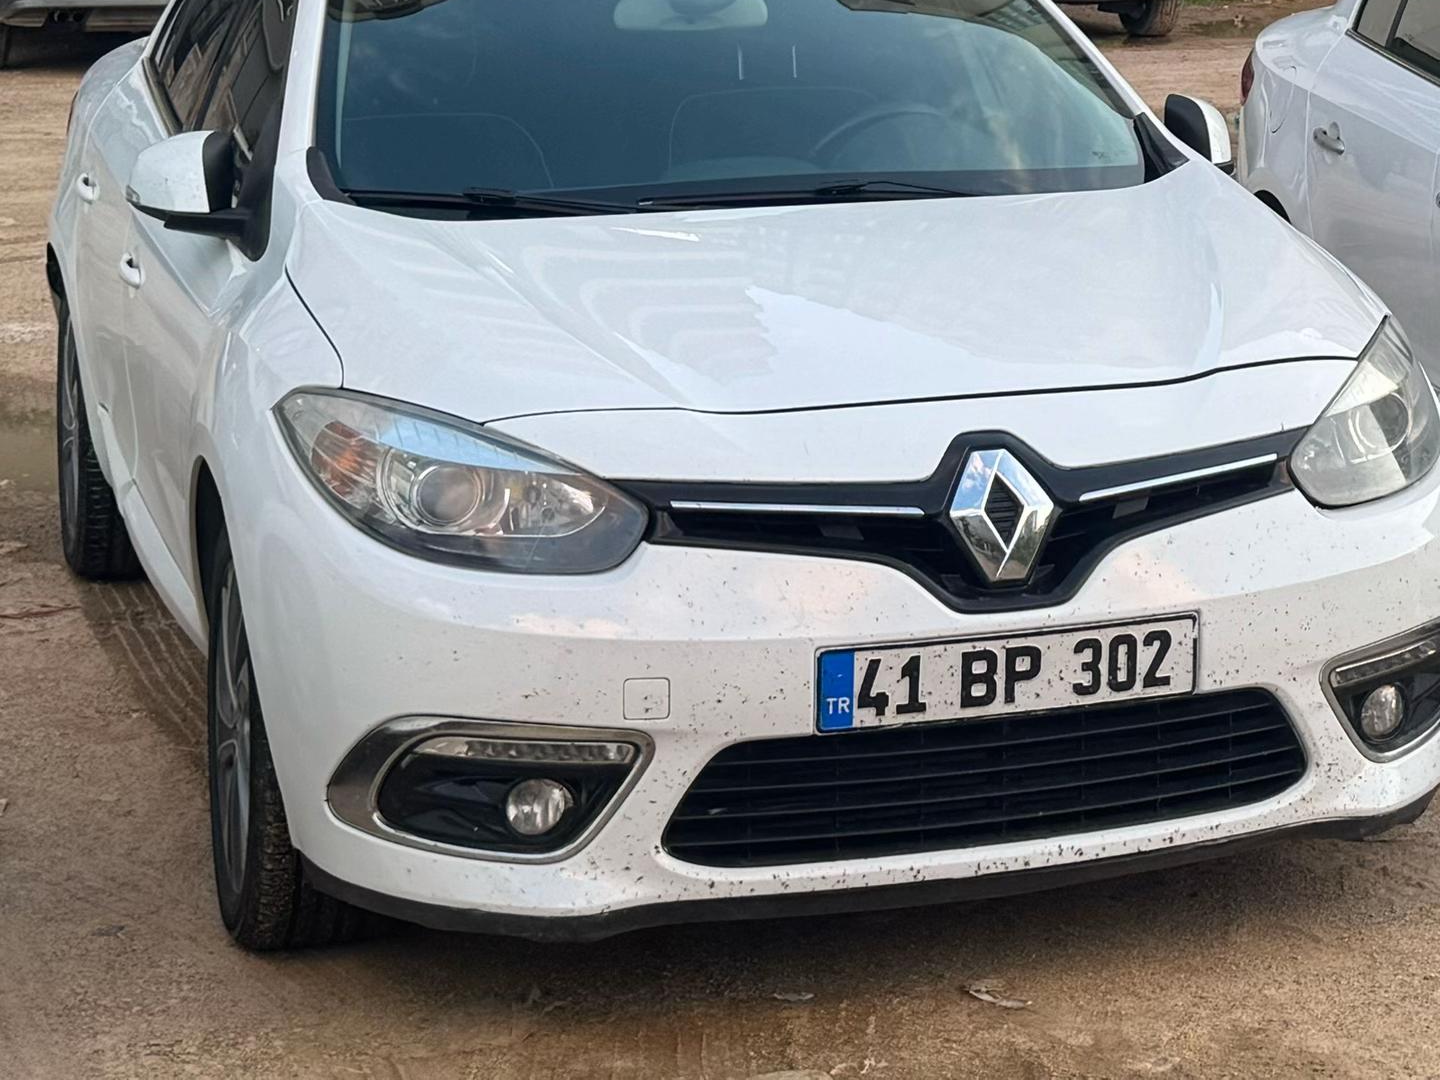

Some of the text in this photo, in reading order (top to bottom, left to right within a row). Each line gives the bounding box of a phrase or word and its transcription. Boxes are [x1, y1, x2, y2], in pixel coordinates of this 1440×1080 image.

[857, 629, 1173, 717] 41 BP 302
[826, 696, 850, 715] TR
